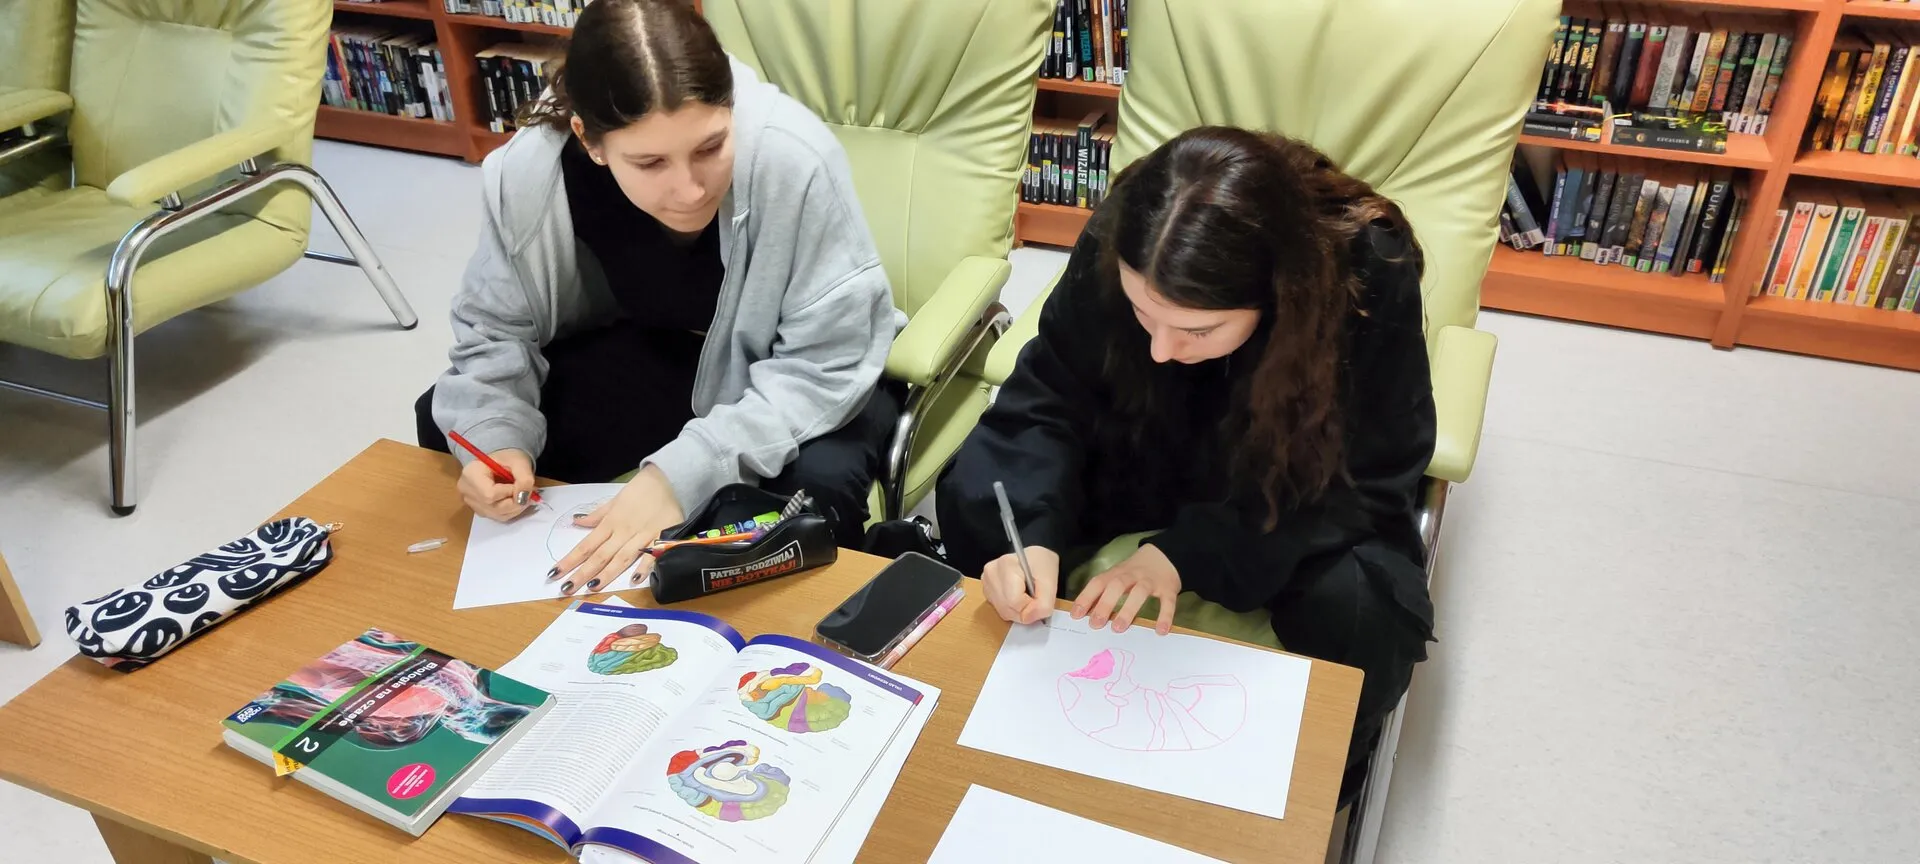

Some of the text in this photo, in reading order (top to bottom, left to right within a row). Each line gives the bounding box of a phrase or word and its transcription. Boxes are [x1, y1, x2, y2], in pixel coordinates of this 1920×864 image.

[1077, 148, 1088, 185] WIZJER
[1702, 184, 1724, 229] DUKAJ
[709, 548, 795, 580] PATRZ, PODZIWIAJ
[711, 559, 796, 590] NIE DOTYKAJ!
[392, 662, 438, 689] Biologia
[375, 688, 393, 700] na
[236, 706, 254, 720] era
[240, 706, 262, 723] nowa
[338, 699, 376, 727] czasie
[295, 736, 320, 753] 2
